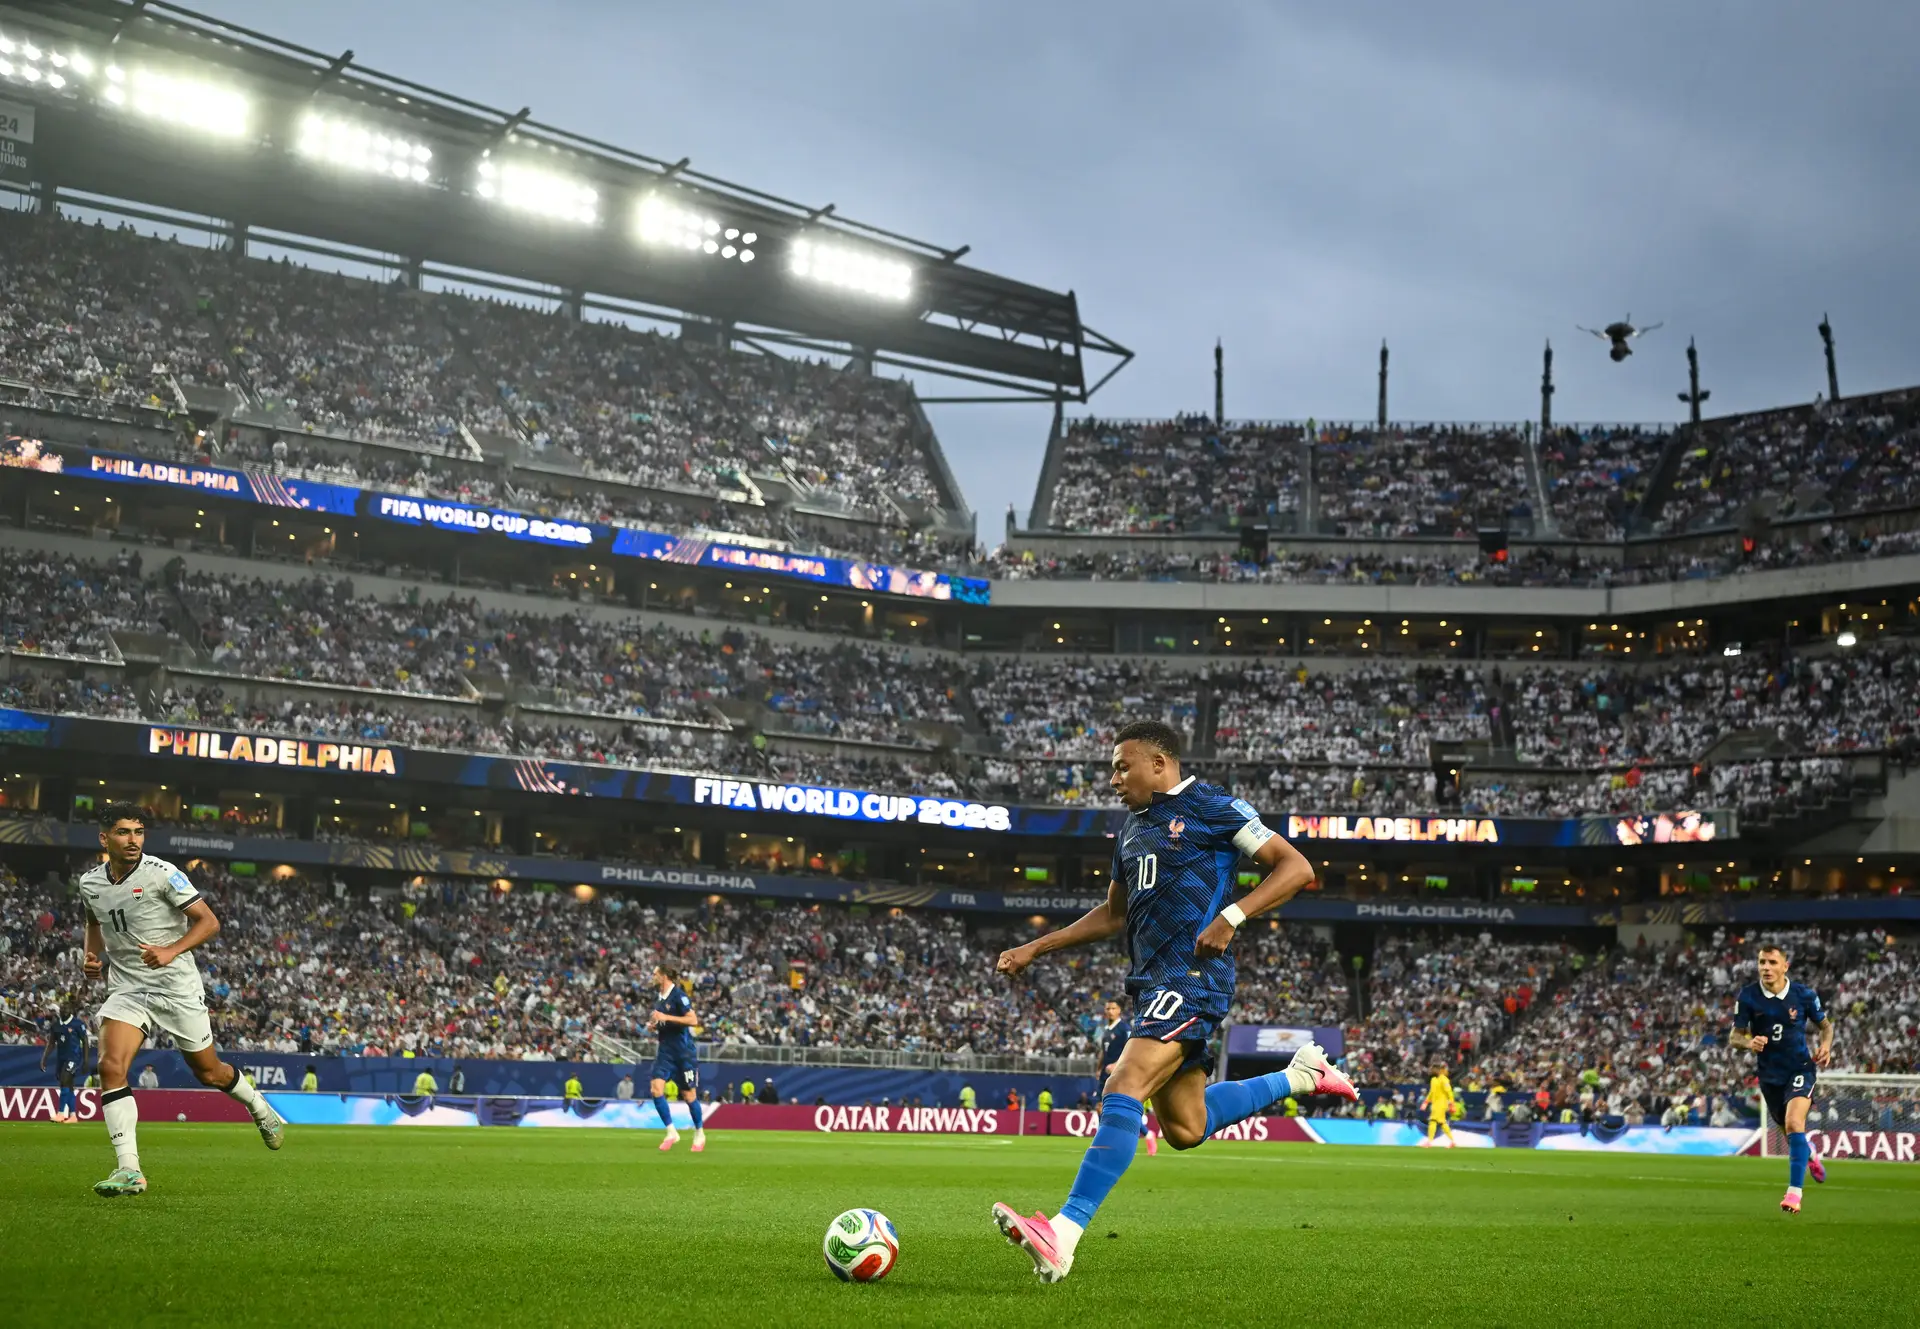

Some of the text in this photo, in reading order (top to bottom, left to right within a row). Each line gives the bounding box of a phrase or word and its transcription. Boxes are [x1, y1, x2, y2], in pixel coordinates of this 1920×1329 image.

[91, 455, 240, 492] PHILADELPHIA
[381, 498, 422, 520] FIFA
[424, 503, 490, 529] WORLD
[491, 514, 528, 534] CUP
[149, 728, 396, 774] PHILADELPHIA
[694, 778, 1010, 831] FIFA WORLD CUP 2026
[1288, 815, 1498, 843] PHILADELPHIA
[602, 866, 757, 890] PHILADELPHIA
[1136, 853, 1157, 891] 10
[951, 893, 1105, 910] FIFA WORLD CUP 20
[1356, 903, 1516, 920] PHILADELPHIA
[108, 908, 128, 933] 11
[1143, 989, 1183, 1020] 10
[1772, 1023, 1783, 1041] 3
[684, 1069, 694, 1083] 14
[814, 1105, 998, 1133] QATAR AIRWAYS
[1805, 1129, 1916, 1162] QATAR
